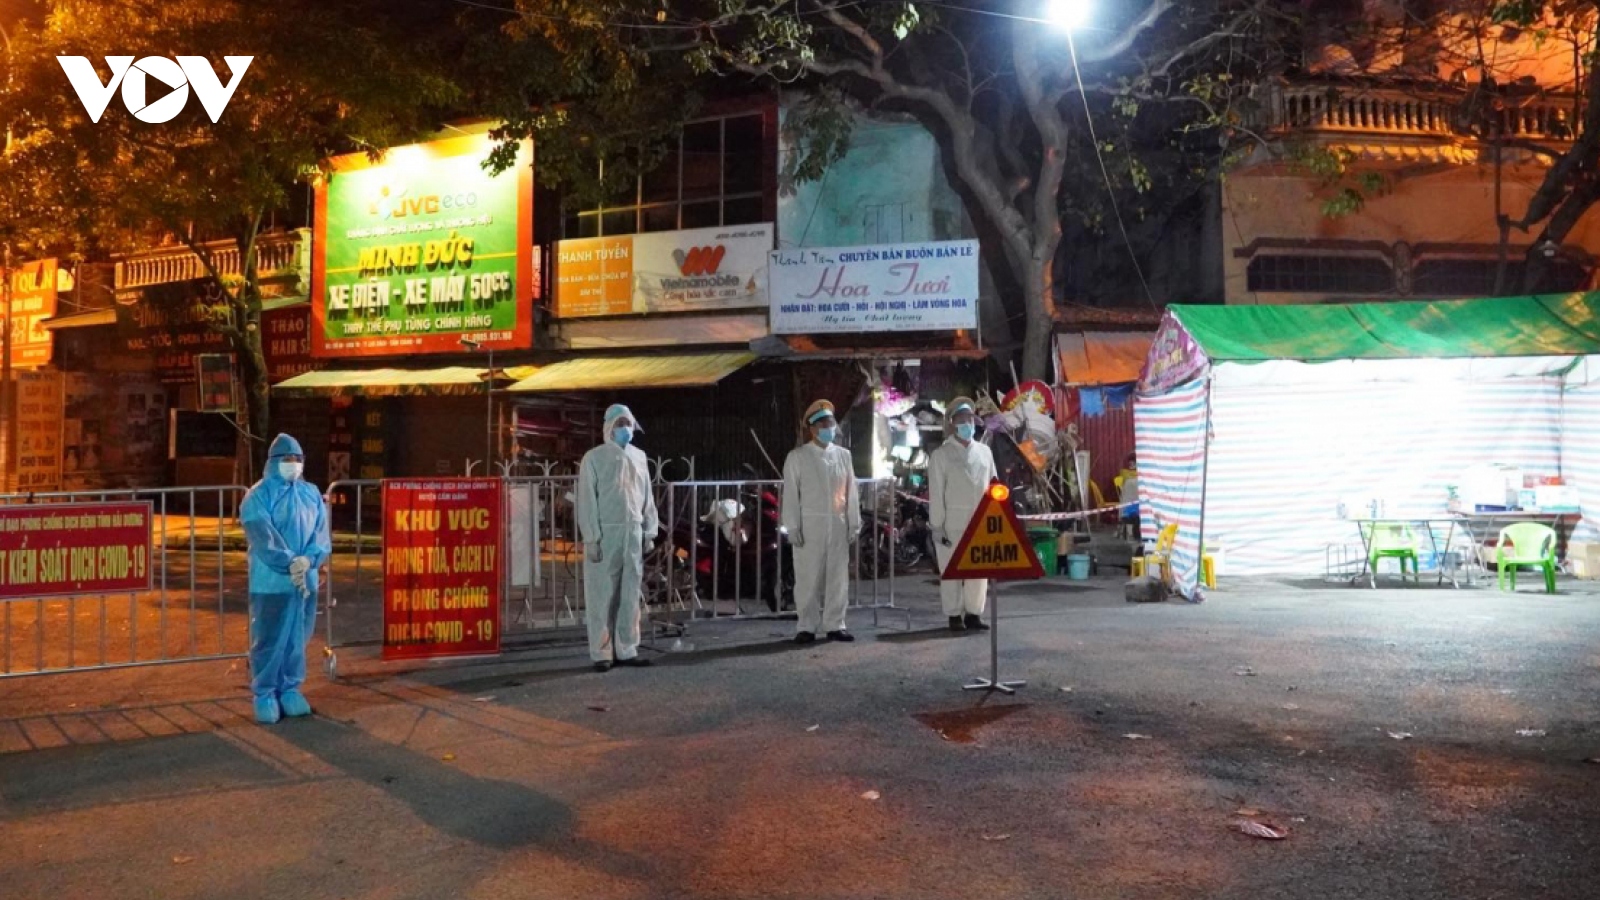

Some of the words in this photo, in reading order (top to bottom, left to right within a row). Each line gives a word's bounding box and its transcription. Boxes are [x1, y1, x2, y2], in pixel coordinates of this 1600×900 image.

[358, 242, 420, 271] MINH
[423, 231, 474, 268] ĐỨC
[839, 249, 879, 263] CHUYÊN
[882, 247, 903, 260] BÁN
[905, 246, 934, 259] BUÔN
[936, 245, 958, 258] BÁN
[329, 285, 349, 310] XE
[353, 277, 390, 313] ĐIỆN
[404, 279, 427, 305] XE
[430, 270, 466, 303] MÁY
[660, 274, 740, 290] Vietnamobile
[796, 264, 871, 299] Hoa
[884, 262, 951, 296] Tươi
[952, 298, 967, 309] HOA
[435, 314, 462, 328] CHÍNH
[271, 338, 298, 356] HAIR
[395, 509, 440, 532] KHU
[448, 506, 490, 535] VỰC
[9, 535, 37, 585] KIỂM
[40, 540, 67, 583] SOÁT
[70, 546, 95, 589] DỊCH
[99, 544, 145, 580] COVID-19
[387, 546, 424, 576] PHONG
[453, 540, 481, 574] CÁCH
[483, 545, 496, 572] LY
[970, 541, 1018, 566] CHẬM
[392, 585, 440, 612] PHÒNG
[443, 579, 488, 610] CHỐNG
[388, 622, 421, 650] DỊCH
[425, 620, 463, 644] COVID
[476, 619, 492, 641] 19
